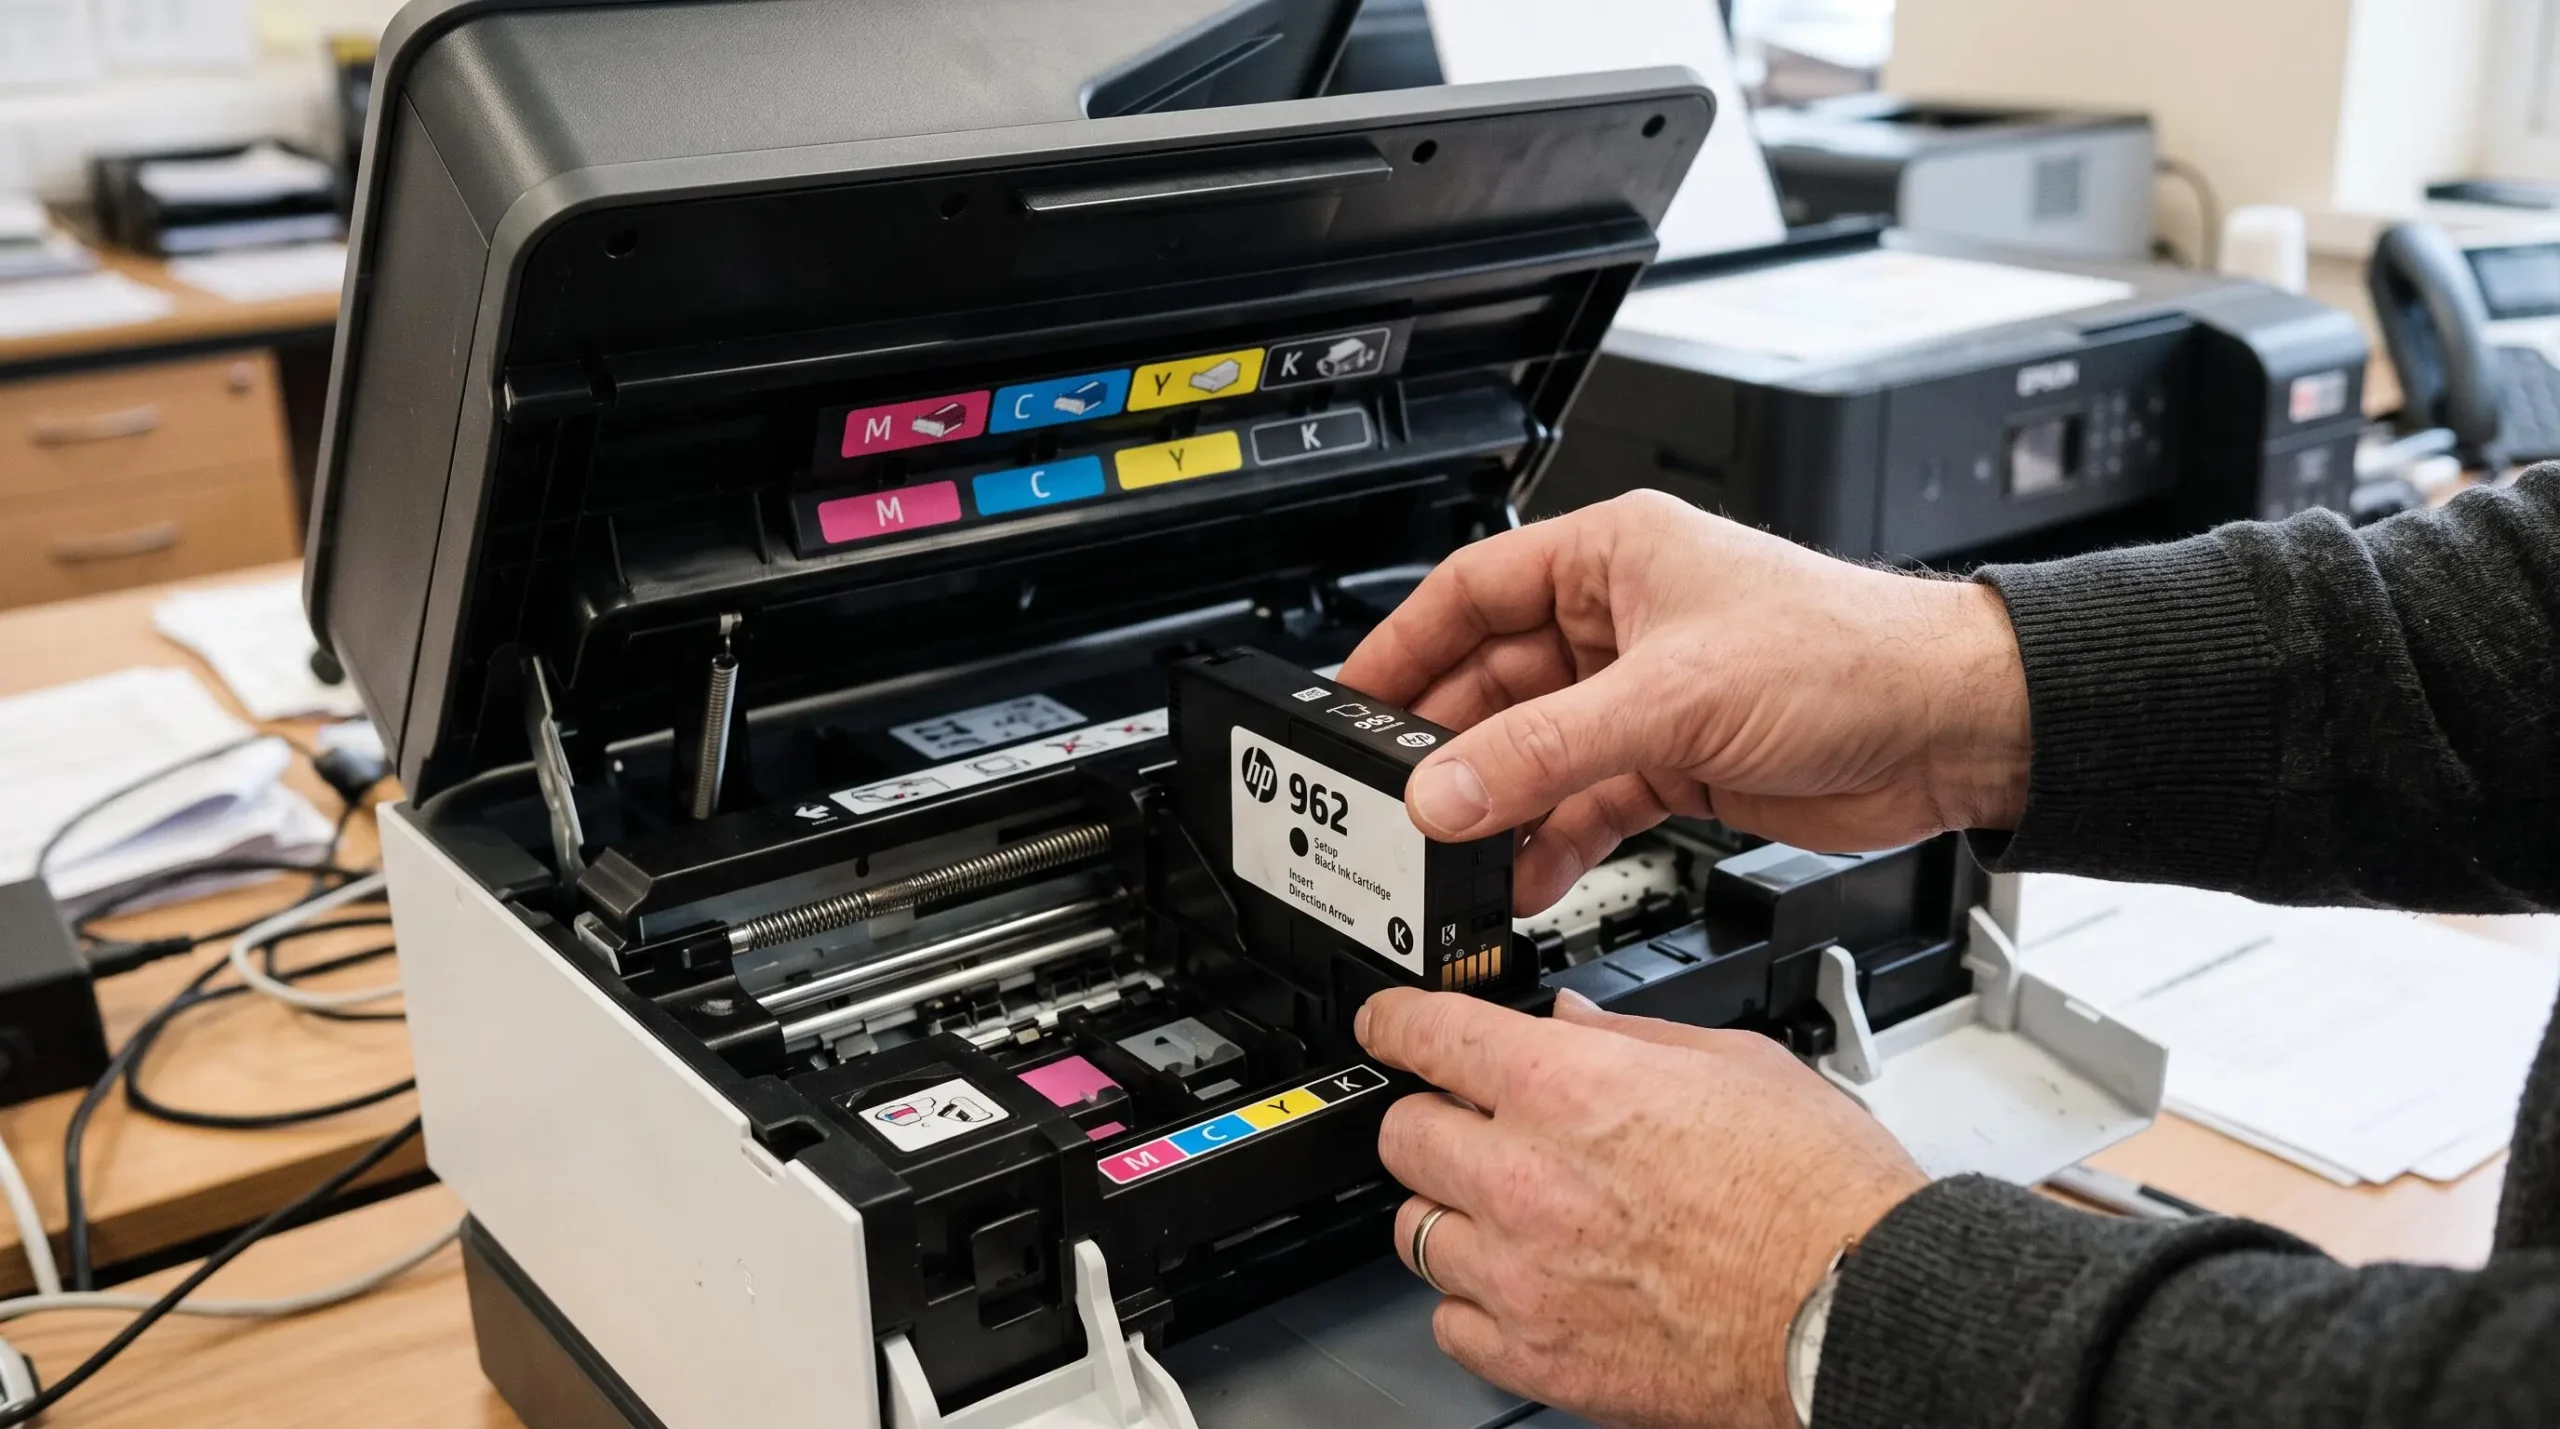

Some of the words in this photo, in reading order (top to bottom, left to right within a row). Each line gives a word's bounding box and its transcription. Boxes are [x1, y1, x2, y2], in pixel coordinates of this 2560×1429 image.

[864, 415, 892, 444] M
[1014, 393, 1034, 420] C
[1154, 372, 1172, 396] Y
[1280, 351, 1303, 377] K
[876, 496, 904, 527] M
[1030, 471, 1051, 499] C
[1169, 448, 1185, 472] Y
[1301, 422, 1322, 450] K
[1245, 746, 1275, 801] hp
[1289, 772, 1349, 837] 962
[1314, 837, 1338, 859] Setup
[1289, 868, 1314, 890] Insert
[1314, 853, 1337, 874] Black
[1338, 864, 1351, 881] Ink
[1352, 872, 1392, 901] Cartridge
[1289, 883, 1327, 913] Direction
[1328, 904, 1355, 927] Arrow
[1394, 922, 1407, 949] K
[1122, 1150, 1160, 1171] M
[1202, 1126, 1227, 1141] C
[1267, 1099, 1291, 1114] Y
[1333, 1076, 1362, 1092] K
